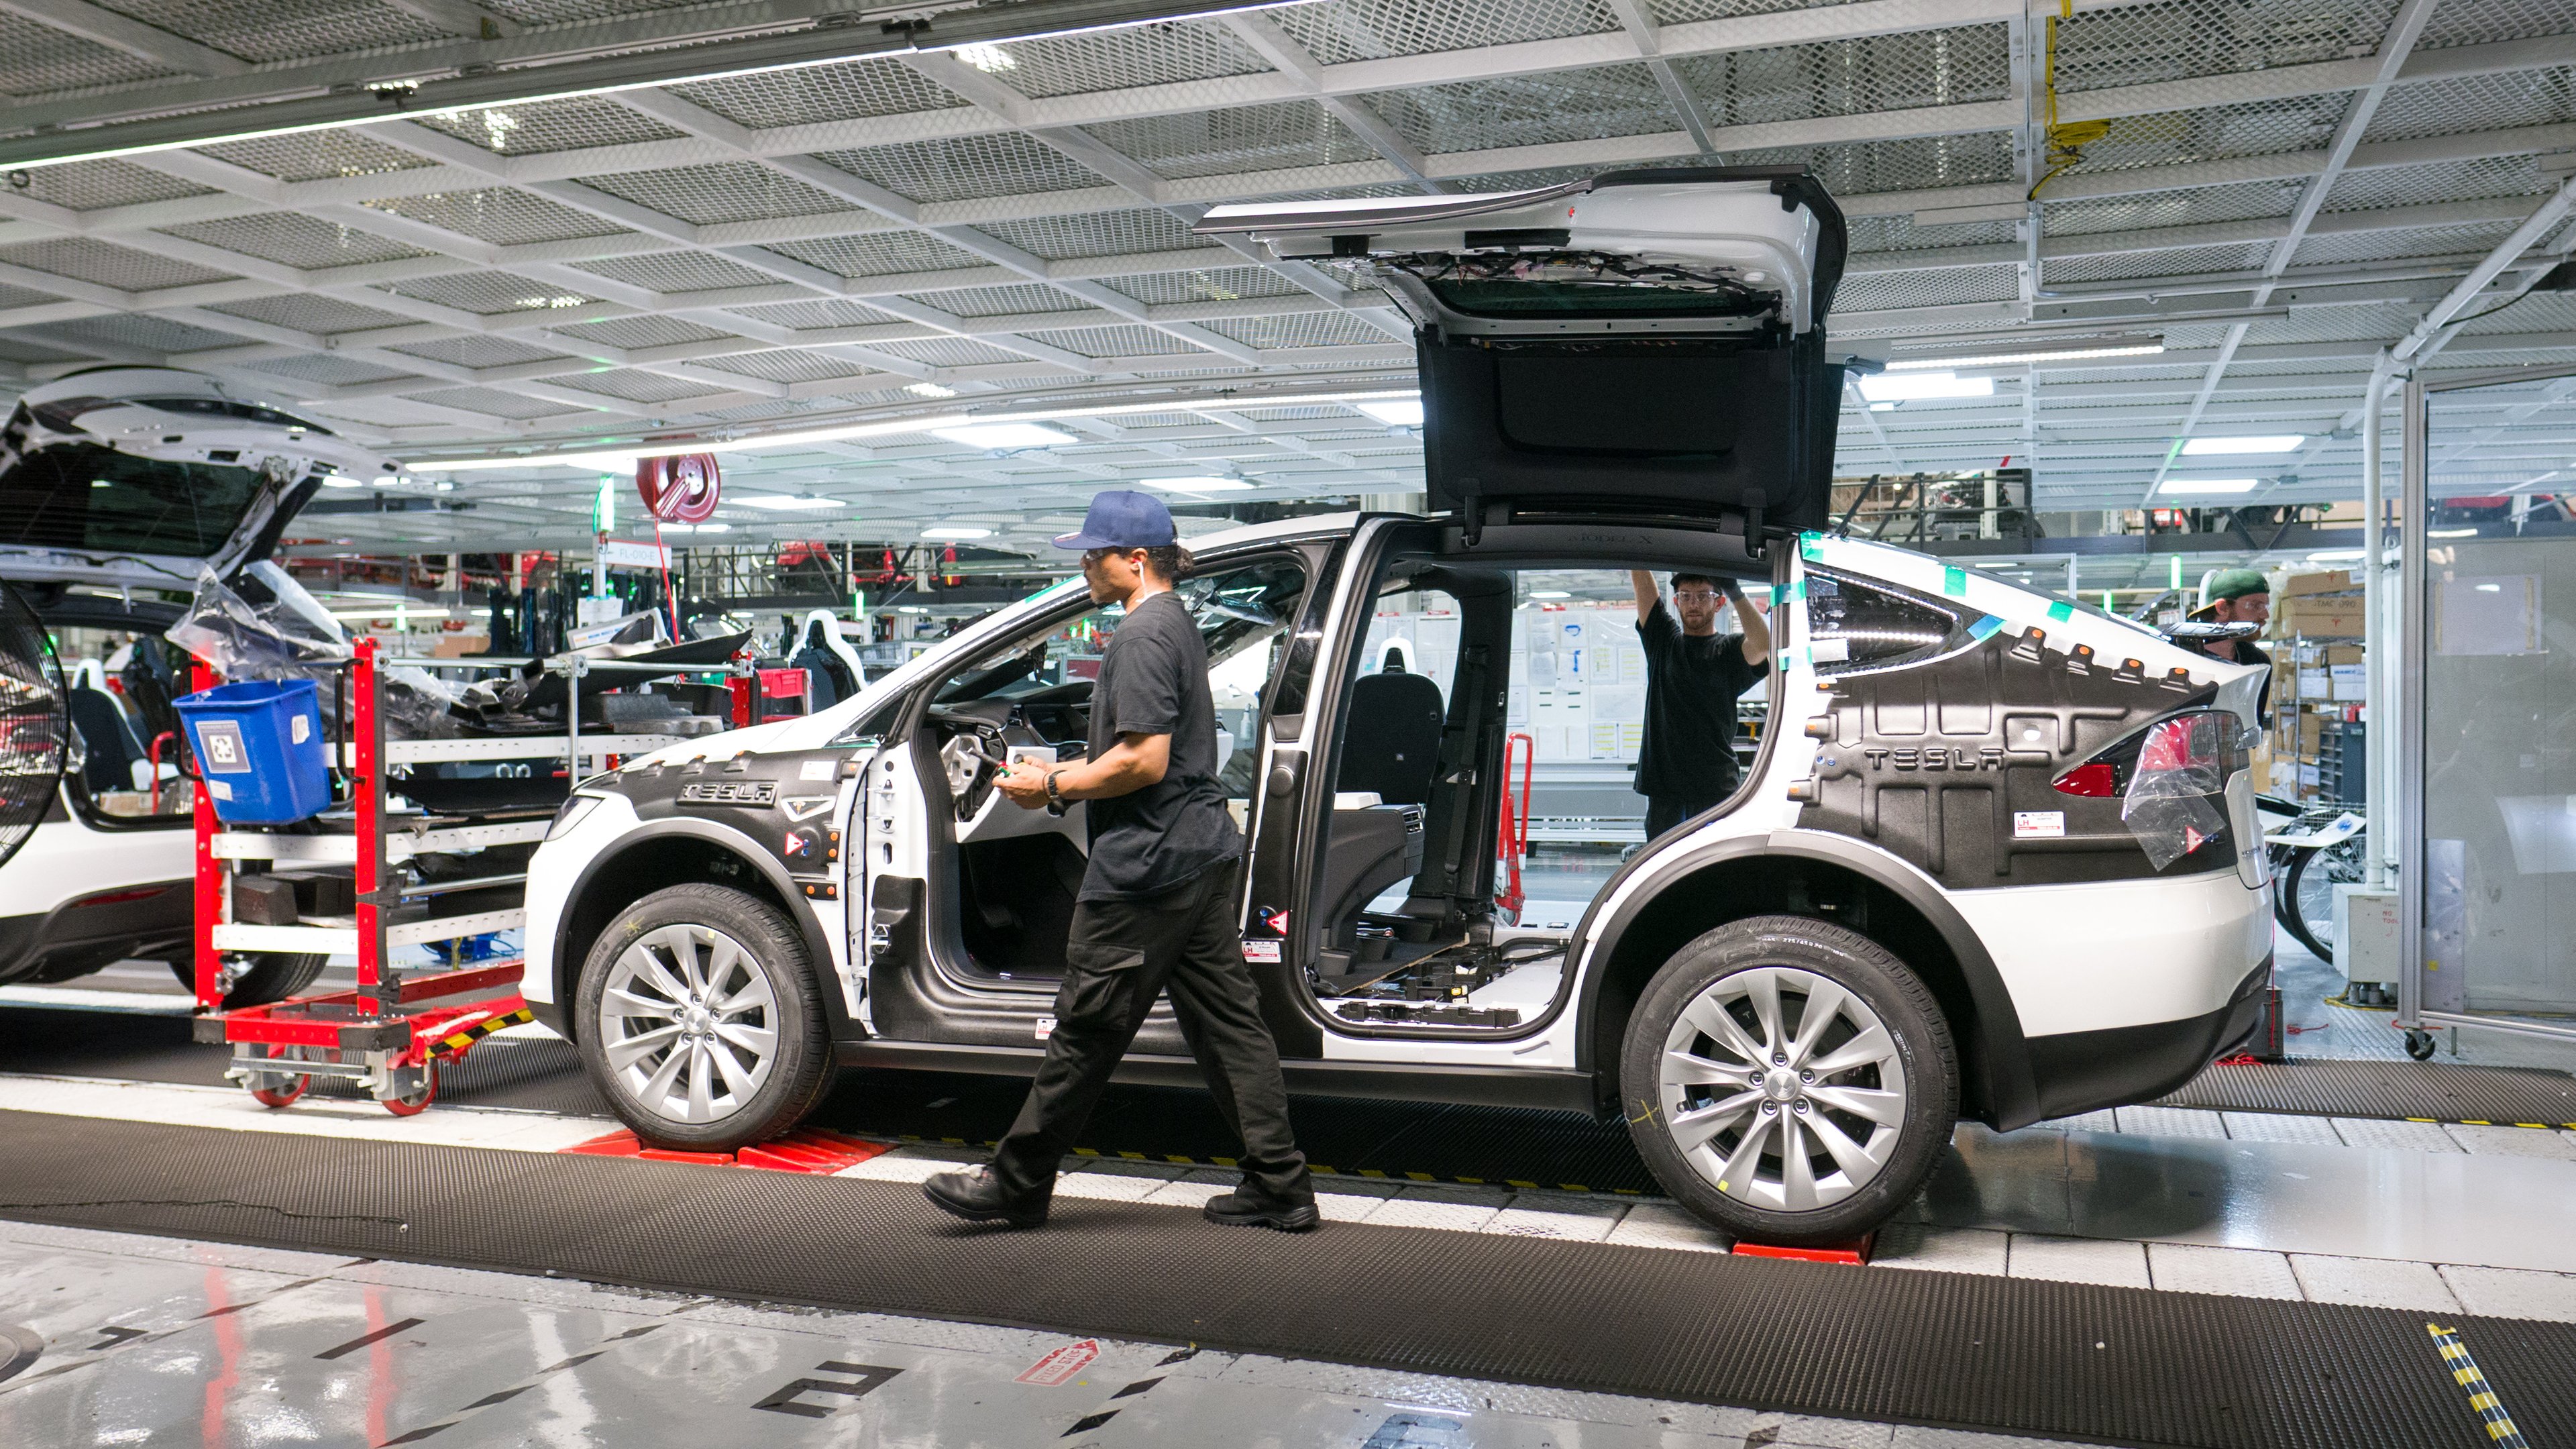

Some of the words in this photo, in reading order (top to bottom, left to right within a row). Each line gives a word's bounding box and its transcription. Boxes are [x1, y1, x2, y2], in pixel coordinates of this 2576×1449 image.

[1864, 749, 2005, 771] TESLA
[683, 783, 774, 801] TESLA
[750, 1360, 906, 1419] 2
